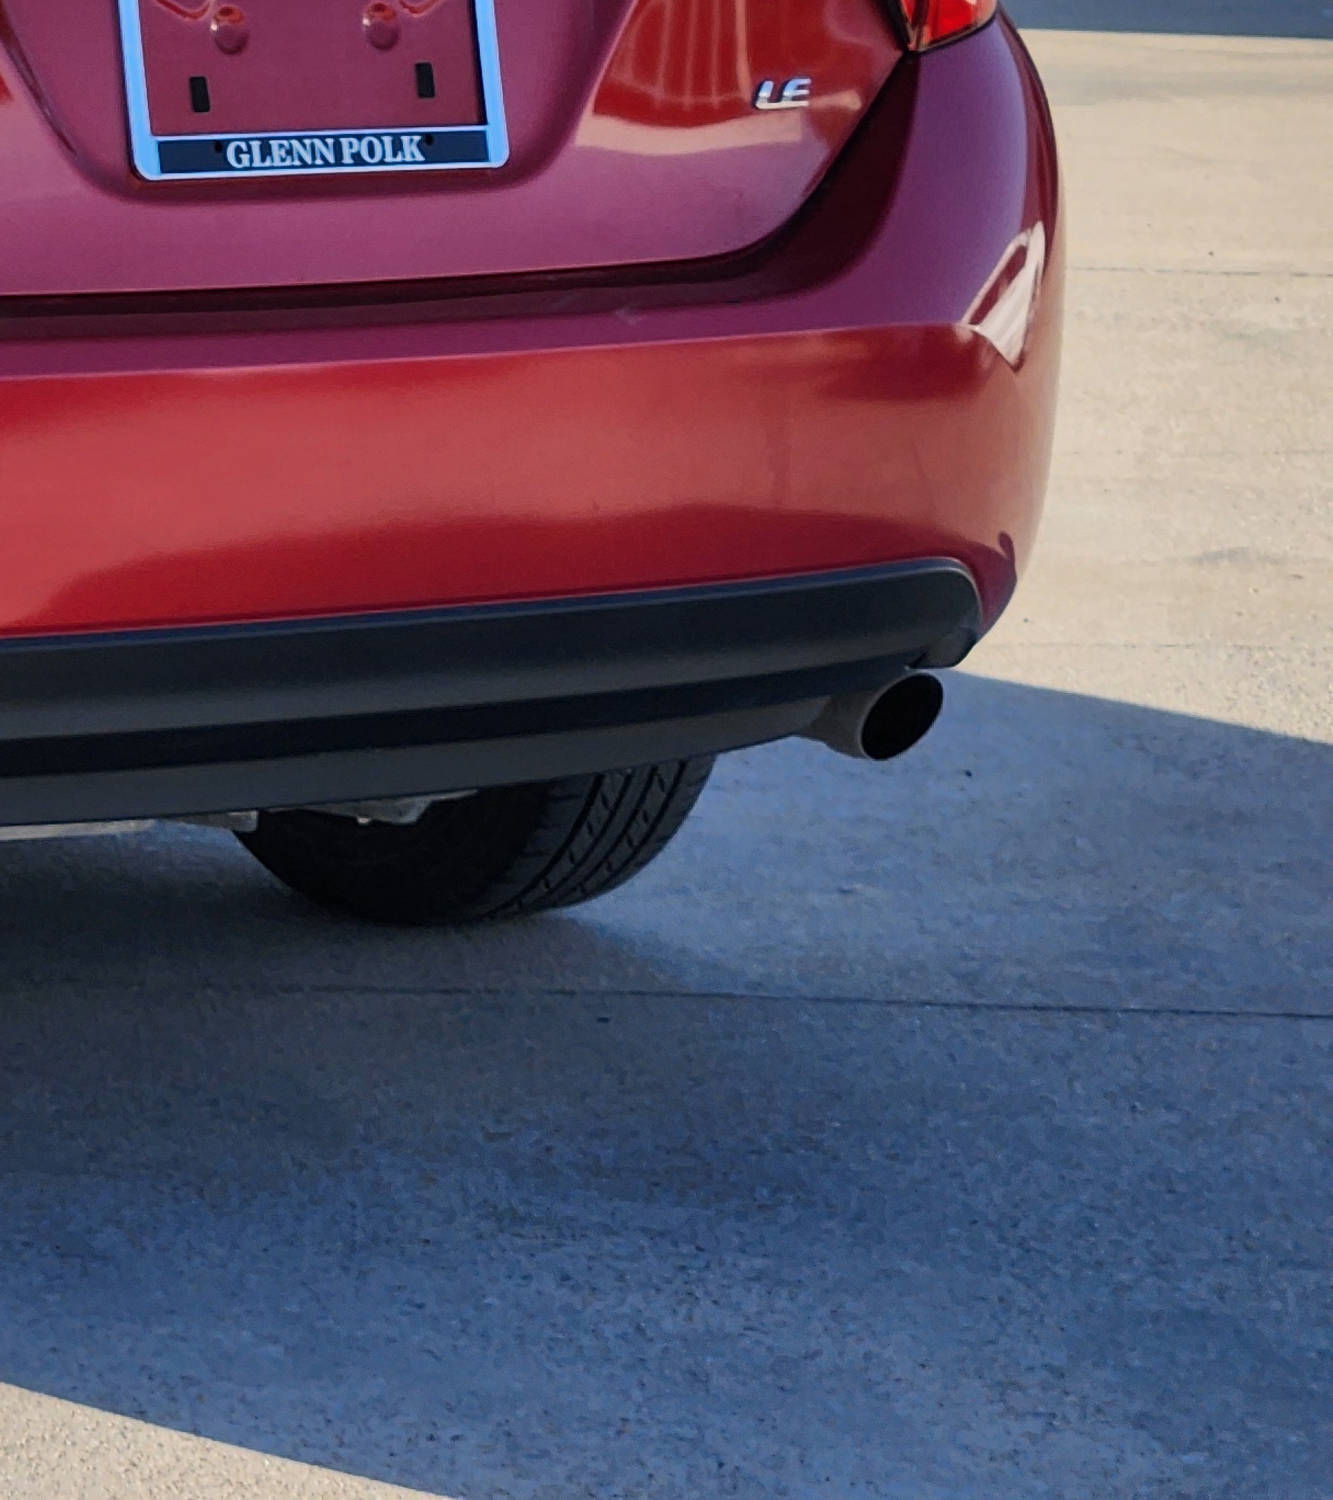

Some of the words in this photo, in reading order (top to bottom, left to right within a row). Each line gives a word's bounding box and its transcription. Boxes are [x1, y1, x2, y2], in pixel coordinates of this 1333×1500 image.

[755, 78, 812, 109] LE
[226, 139, 336, 169] GLENN
[341, 136, 426, 165] POLK
